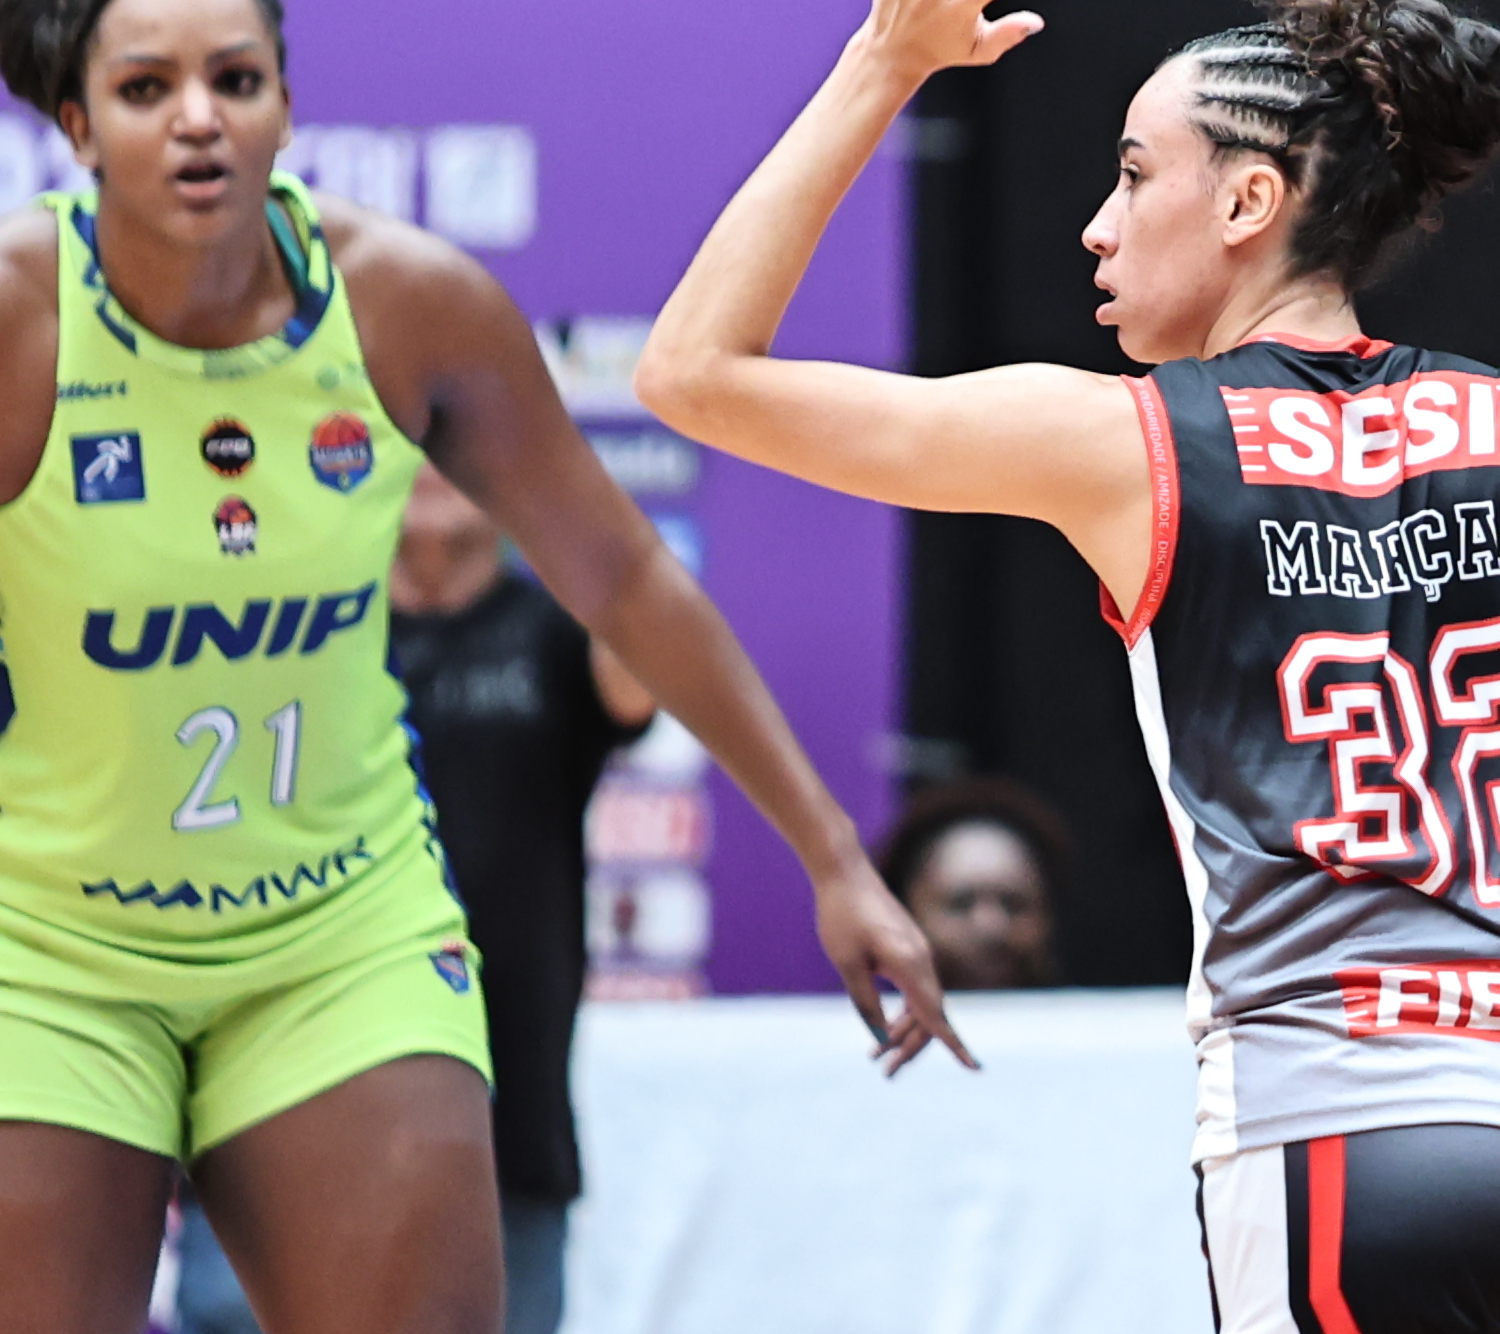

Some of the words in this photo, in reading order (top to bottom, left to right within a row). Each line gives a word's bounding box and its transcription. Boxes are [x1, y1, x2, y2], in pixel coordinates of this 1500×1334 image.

[1266, 380, 1498, 488] SESI
[80, 578, 379, 672] UNIP
[170, 697, 302, 832] 21
